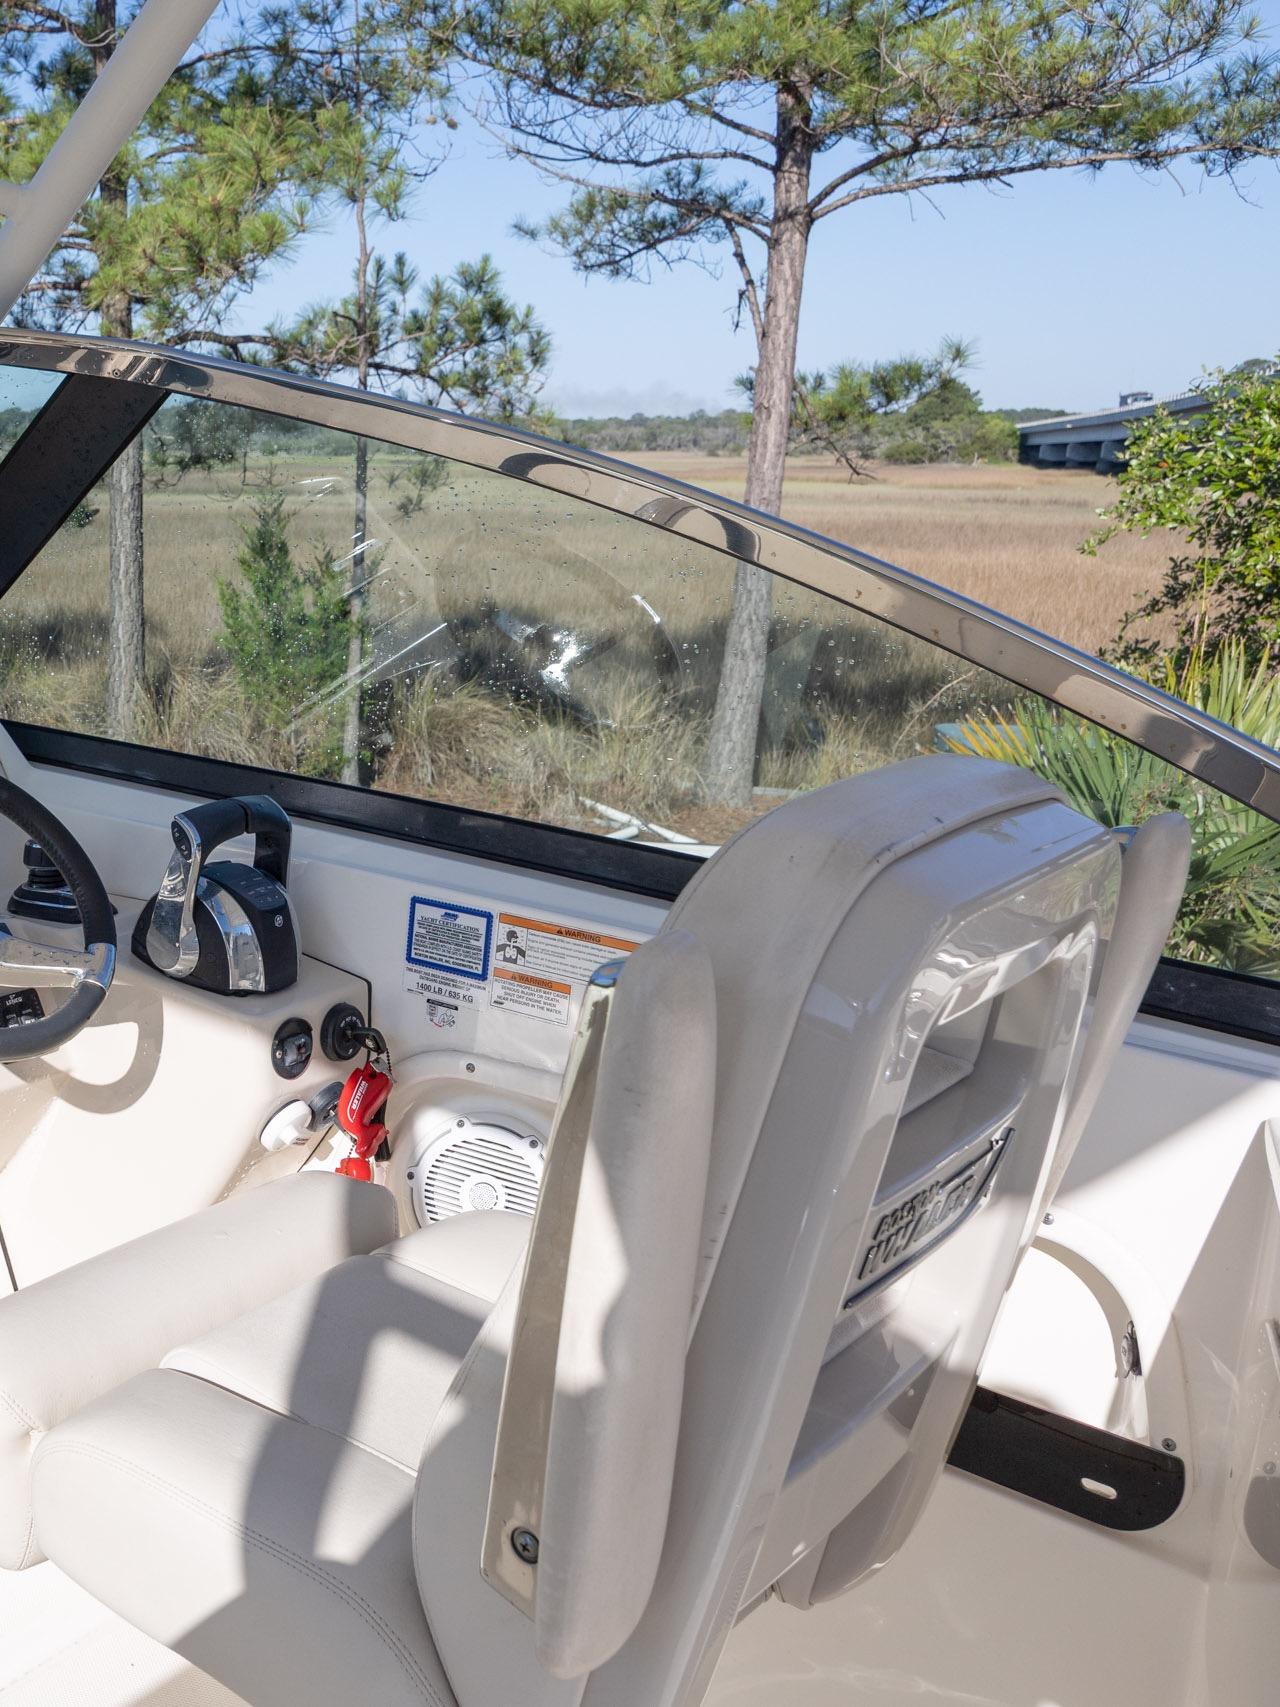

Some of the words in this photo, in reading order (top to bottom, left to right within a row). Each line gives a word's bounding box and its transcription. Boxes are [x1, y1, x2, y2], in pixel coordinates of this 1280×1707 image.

[421, 915, 438, 924] YACHT
[439, 919, 480, 933] CERTIFICATION
[564, 929, 601, 942] WARNING
[518, 975, 552, 988] WARNING
[417, 982, 432, 992] 1400
[433, 987, 443, 995] LB
[448, 991, 461, 1000] 635
[462, 994, 473, 1003] KG
[352, 1080, 367, 1110] WHALER
